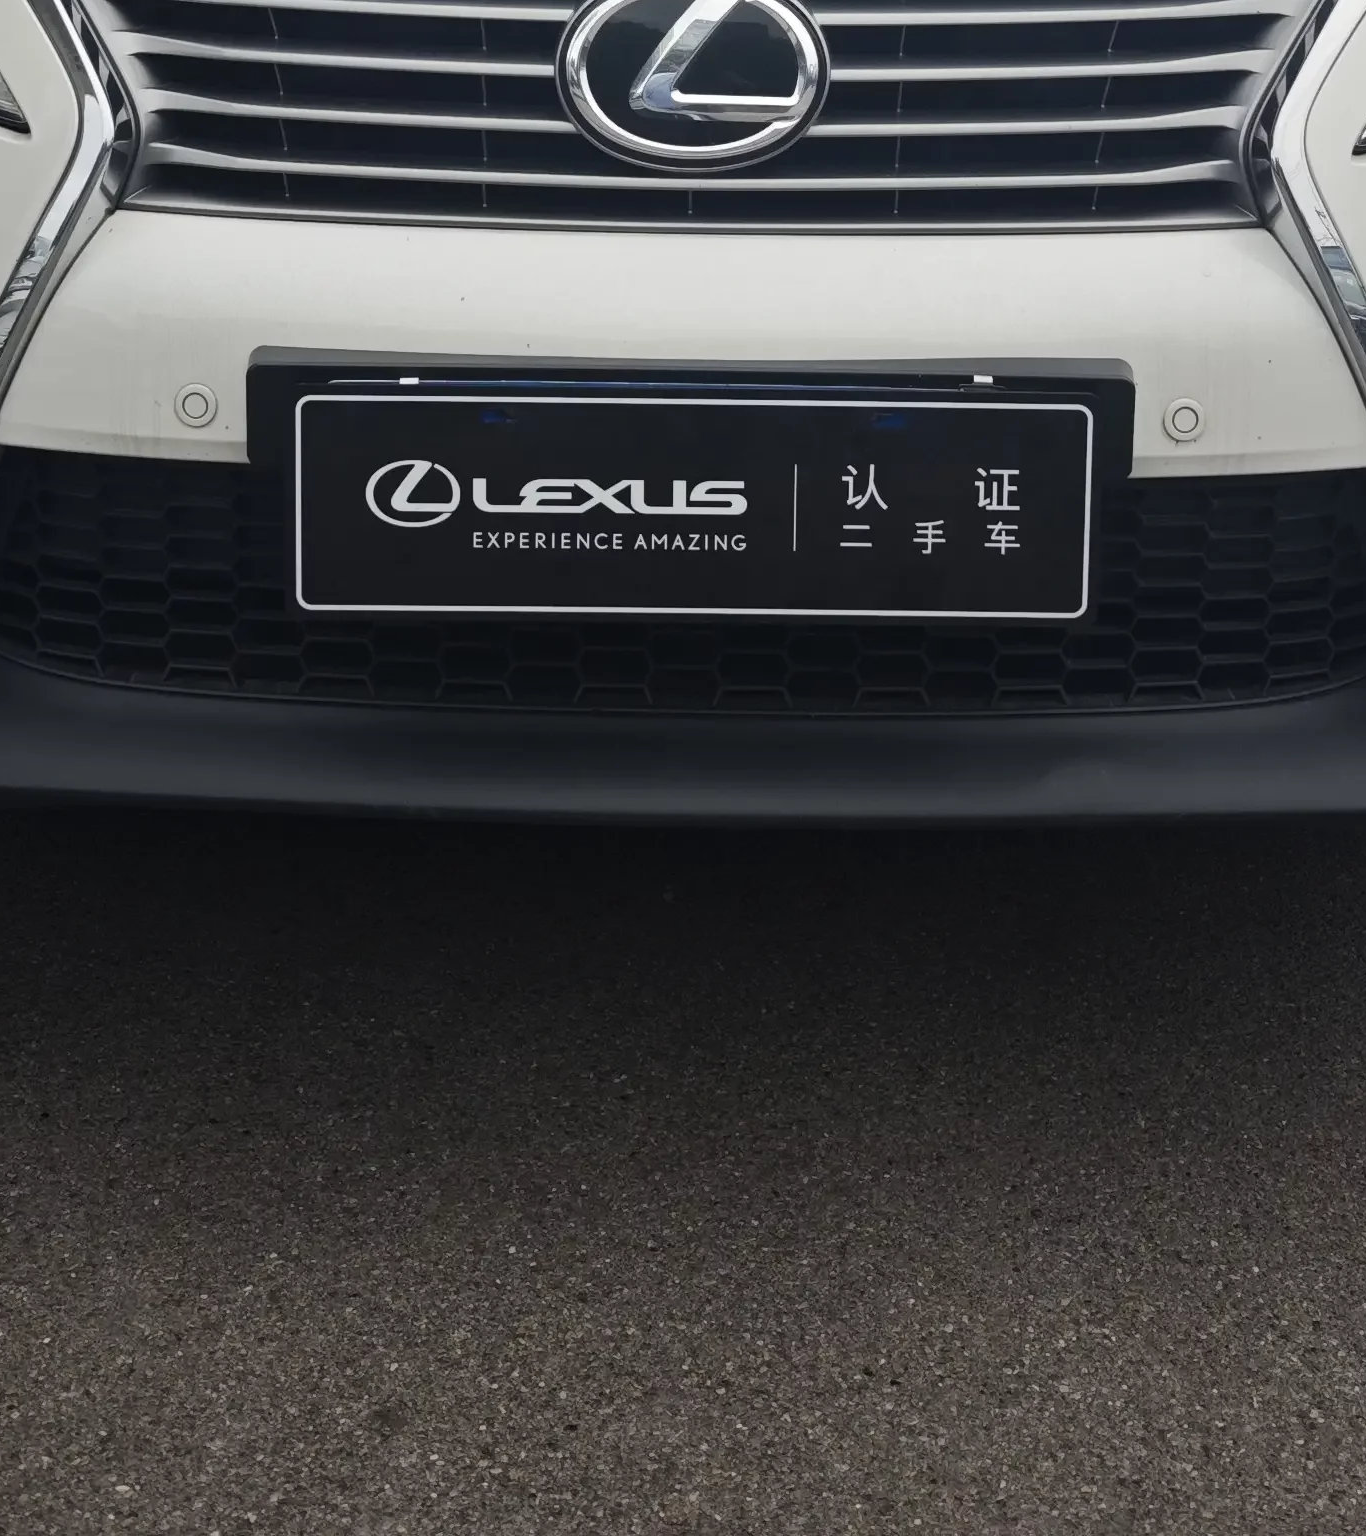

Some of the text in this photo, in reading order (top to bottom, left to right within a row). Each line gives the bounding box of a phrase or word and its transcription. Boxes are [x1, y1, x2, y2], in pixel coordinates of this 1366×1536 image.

[473, 478, 747, 516] LEXUS
[841, 464, 1021, 512] 认证
[473, 531, 747, 551] EXPERIENCE AMAZING
[839, 519, 1021, 555] 二手车
